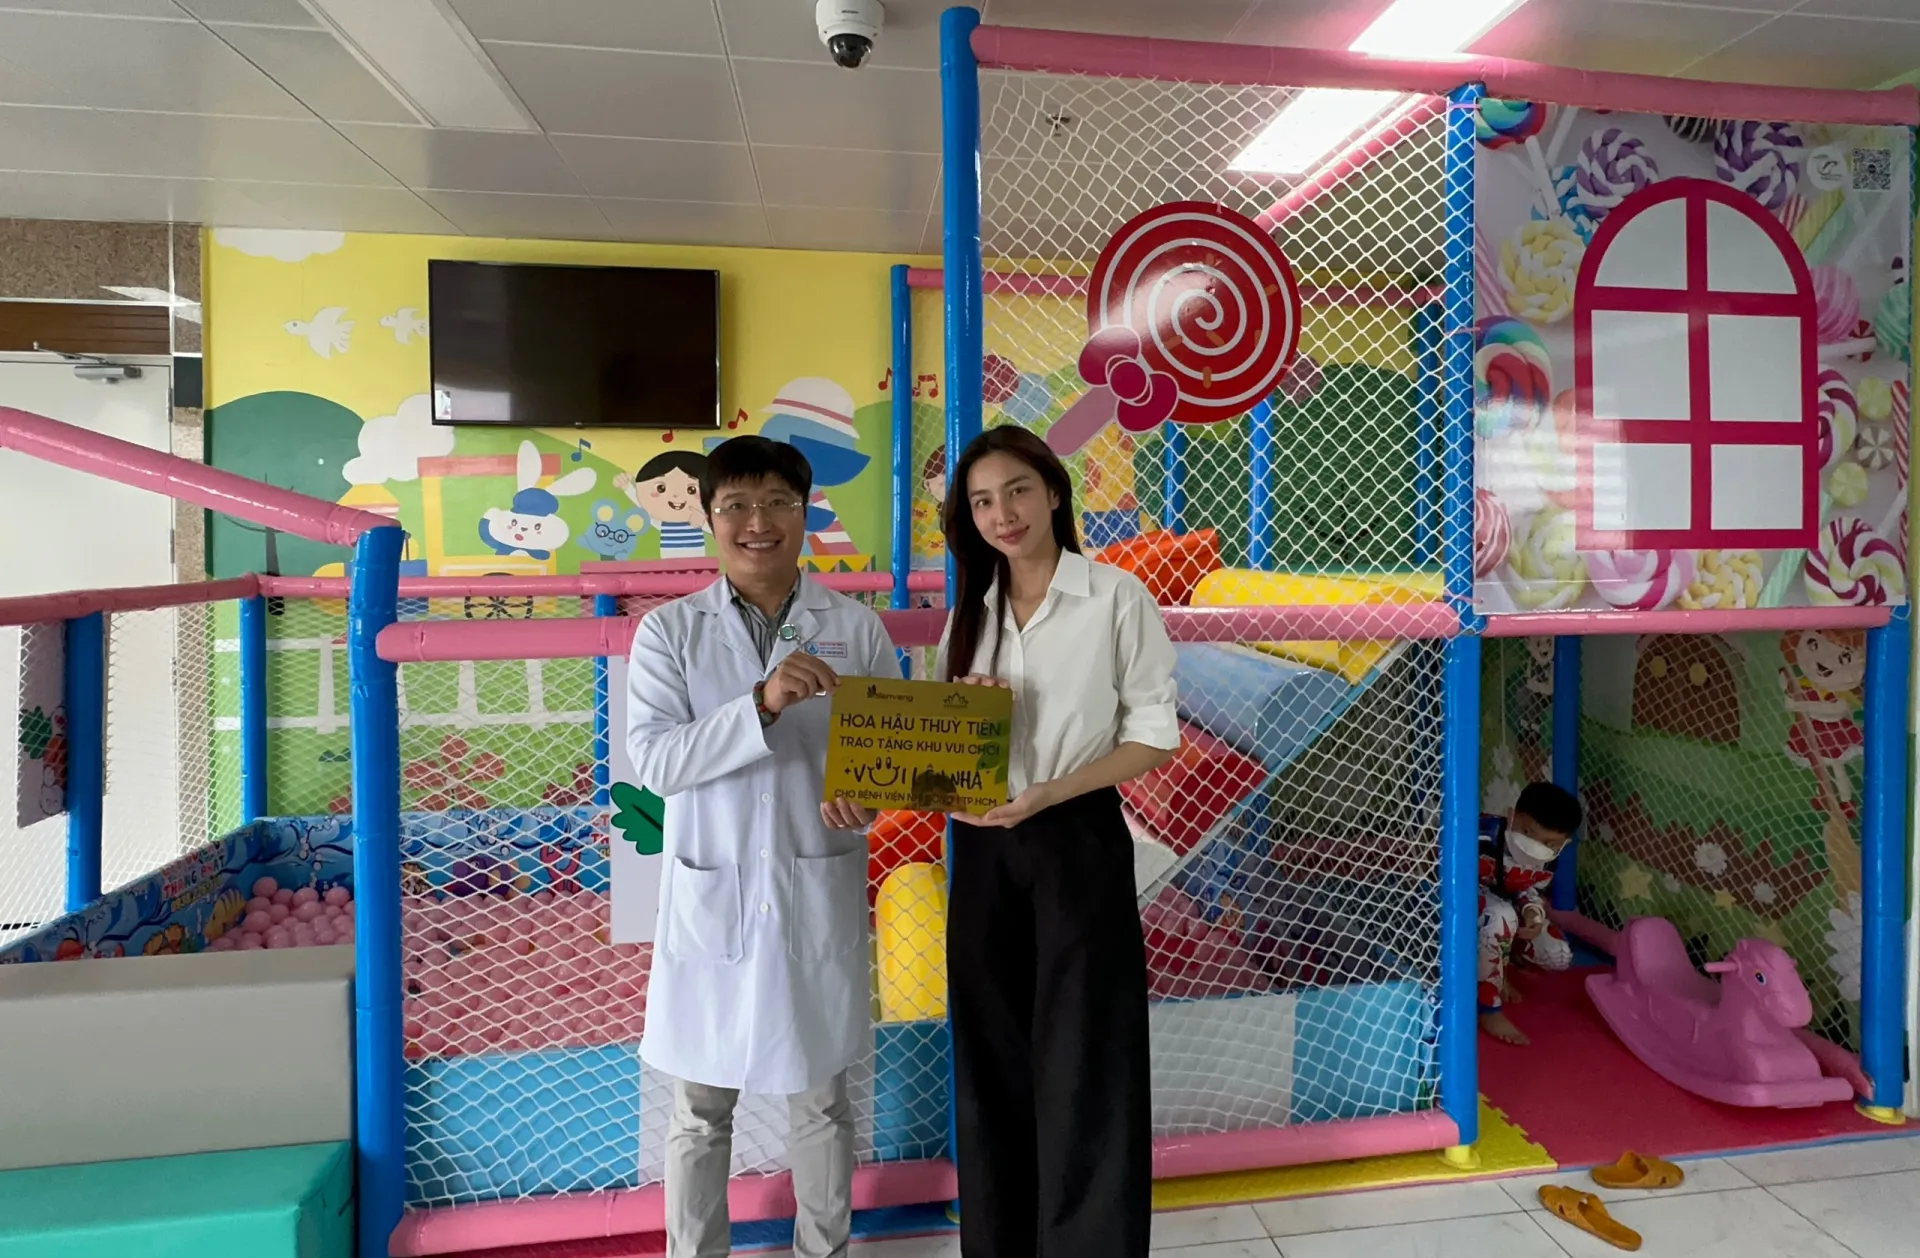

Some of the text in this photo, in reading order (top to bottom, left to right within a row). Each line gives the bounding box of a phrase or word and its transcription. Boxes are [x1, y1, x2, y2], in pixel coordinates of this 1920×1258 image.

[840, 713, 1000, 737] HOA HẬU THUỲ TIÊN
[839, 735, 1000, 756] TRAO TẶNG KHU VUI CHƠI
[834, 788, 856, 799] CHO
[858, 788, 882, 802] BỆNH
[884, 790, 905, 803] VIỆN
